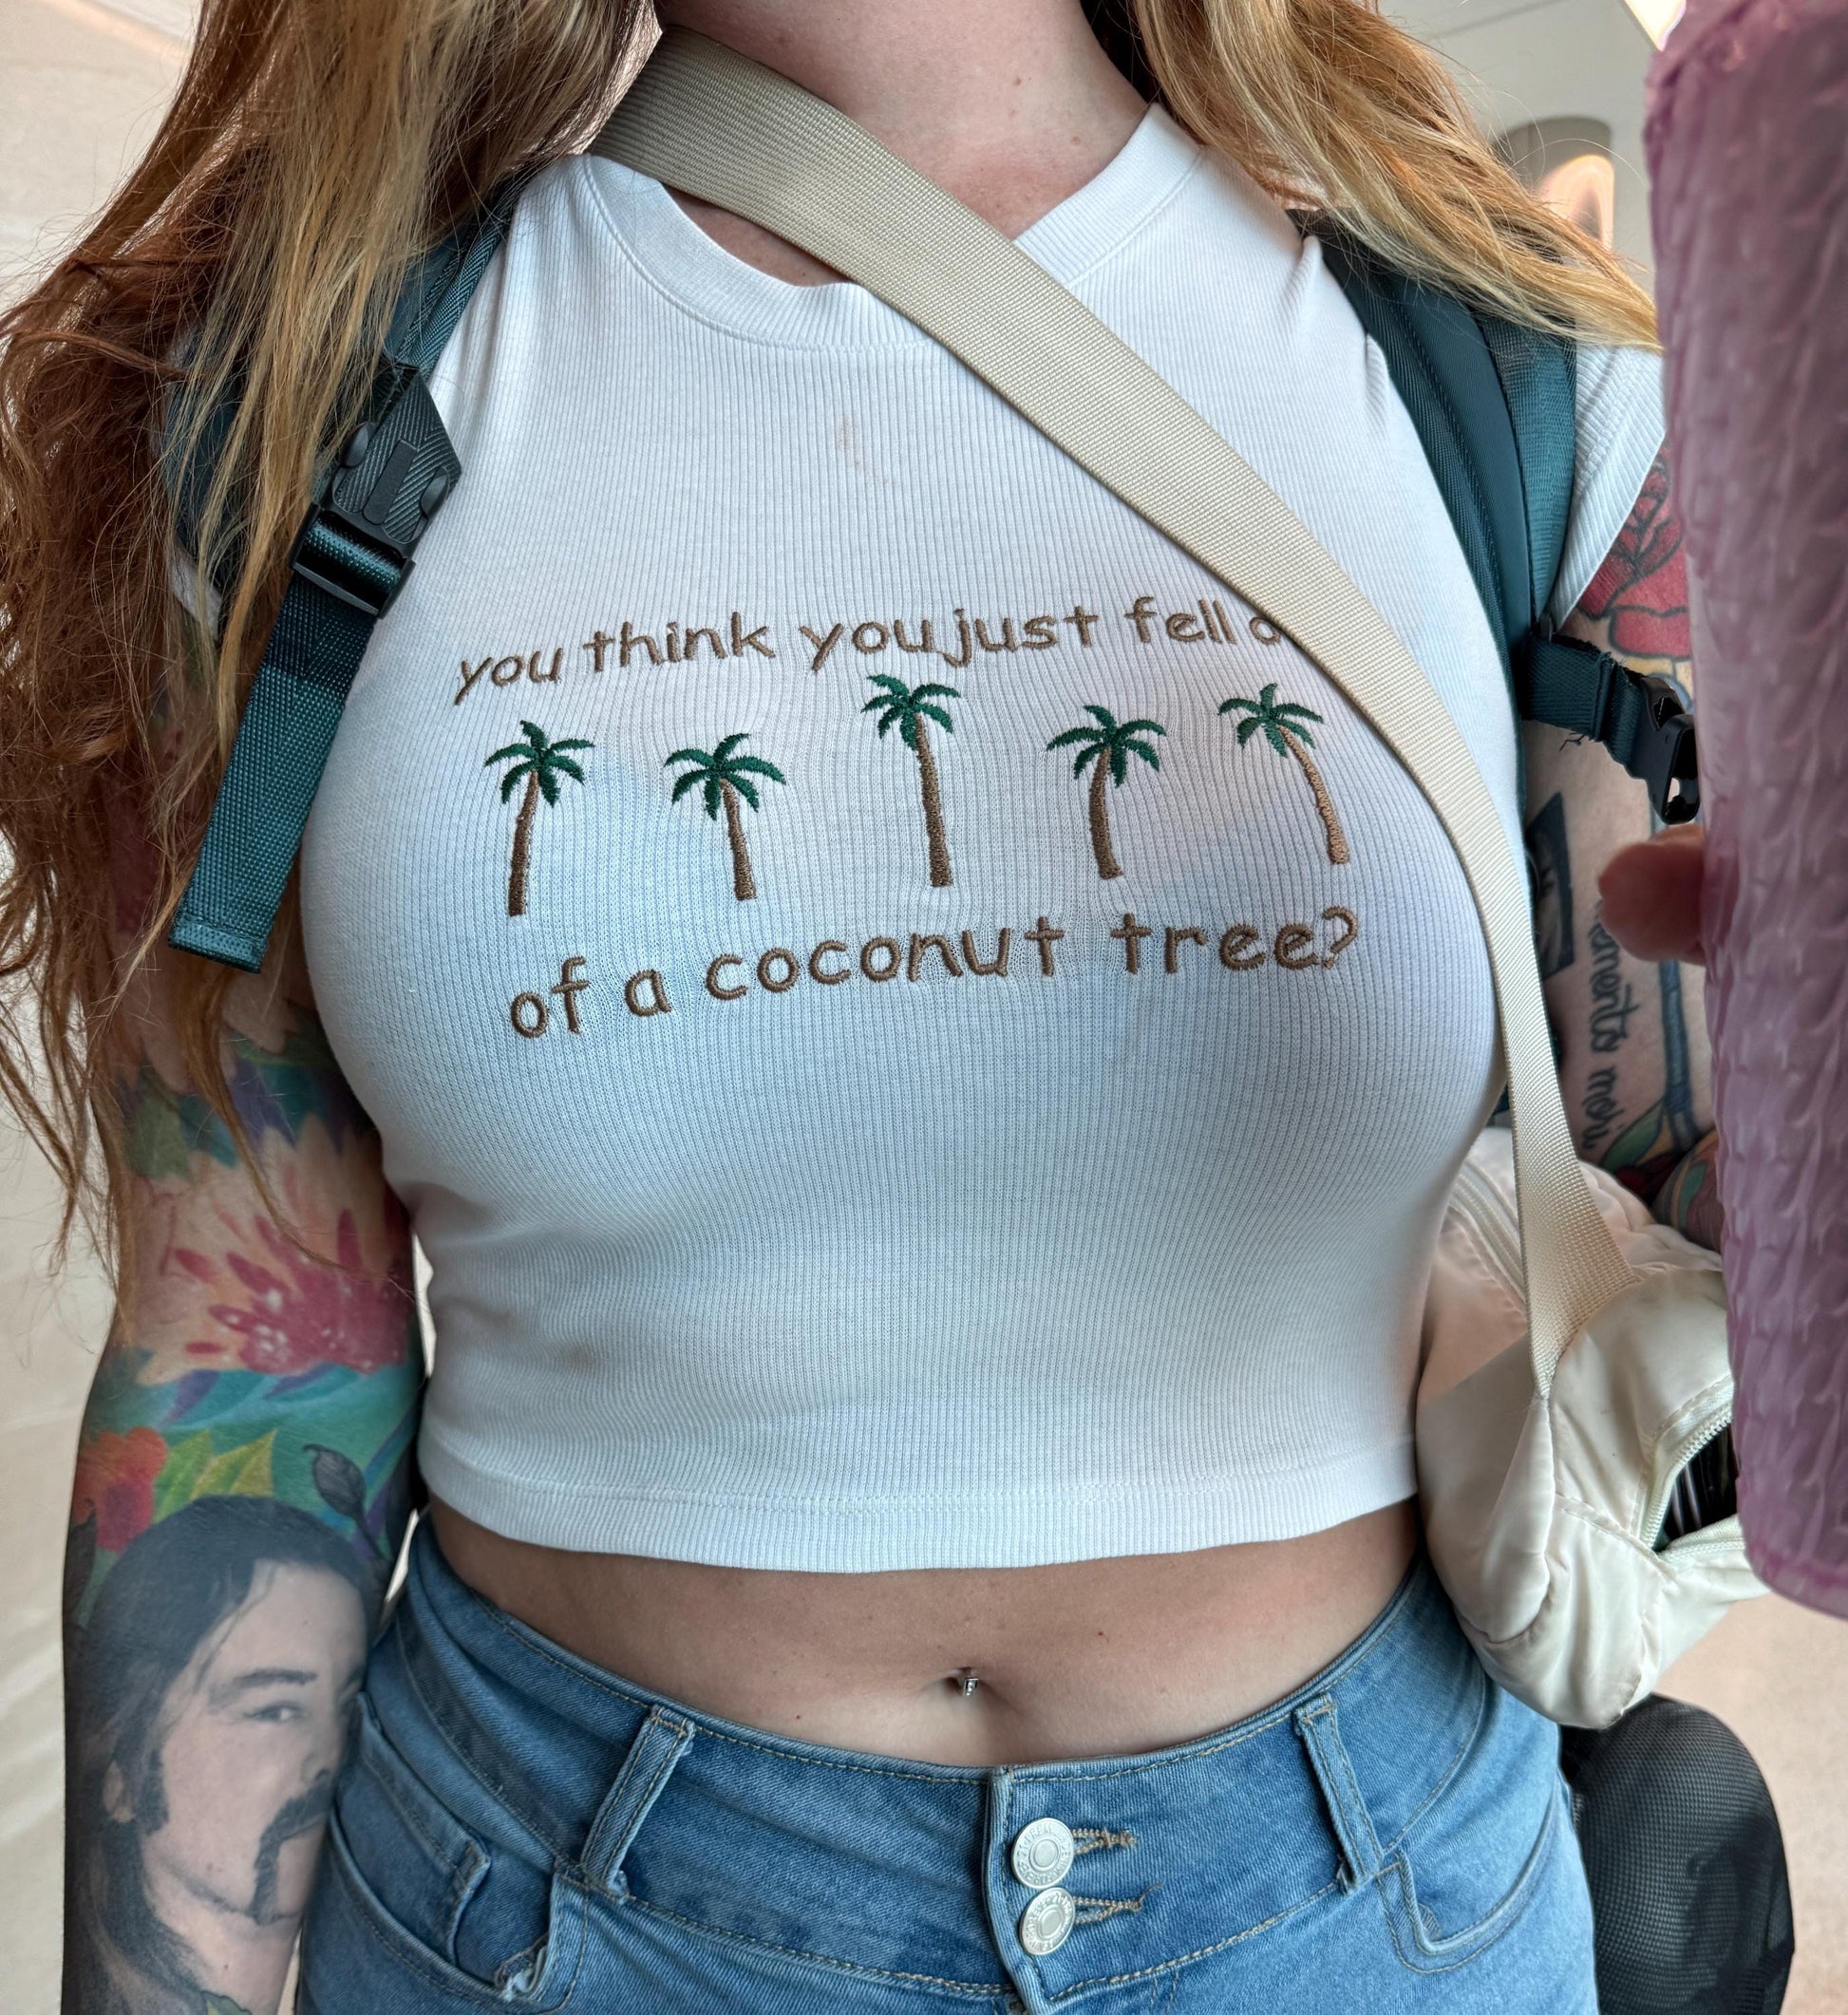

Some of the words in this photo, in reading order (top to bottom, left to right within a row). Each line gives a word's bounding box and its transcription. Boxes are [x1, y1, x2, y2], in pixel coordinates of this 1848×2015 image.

[454, 647, 563, 706] you
[583, 611, 777, 672] think
[798, 619, 934, 674] you
[939, 605, 1100, 668] just
[1125, 595, 1237, 645] fell
[510, 956, 591, 1039] of
[624, 969, 672, 1018] a
[706, 916, 1065, 1002] coconut
[1110, 904, 1360, 975] tree?
